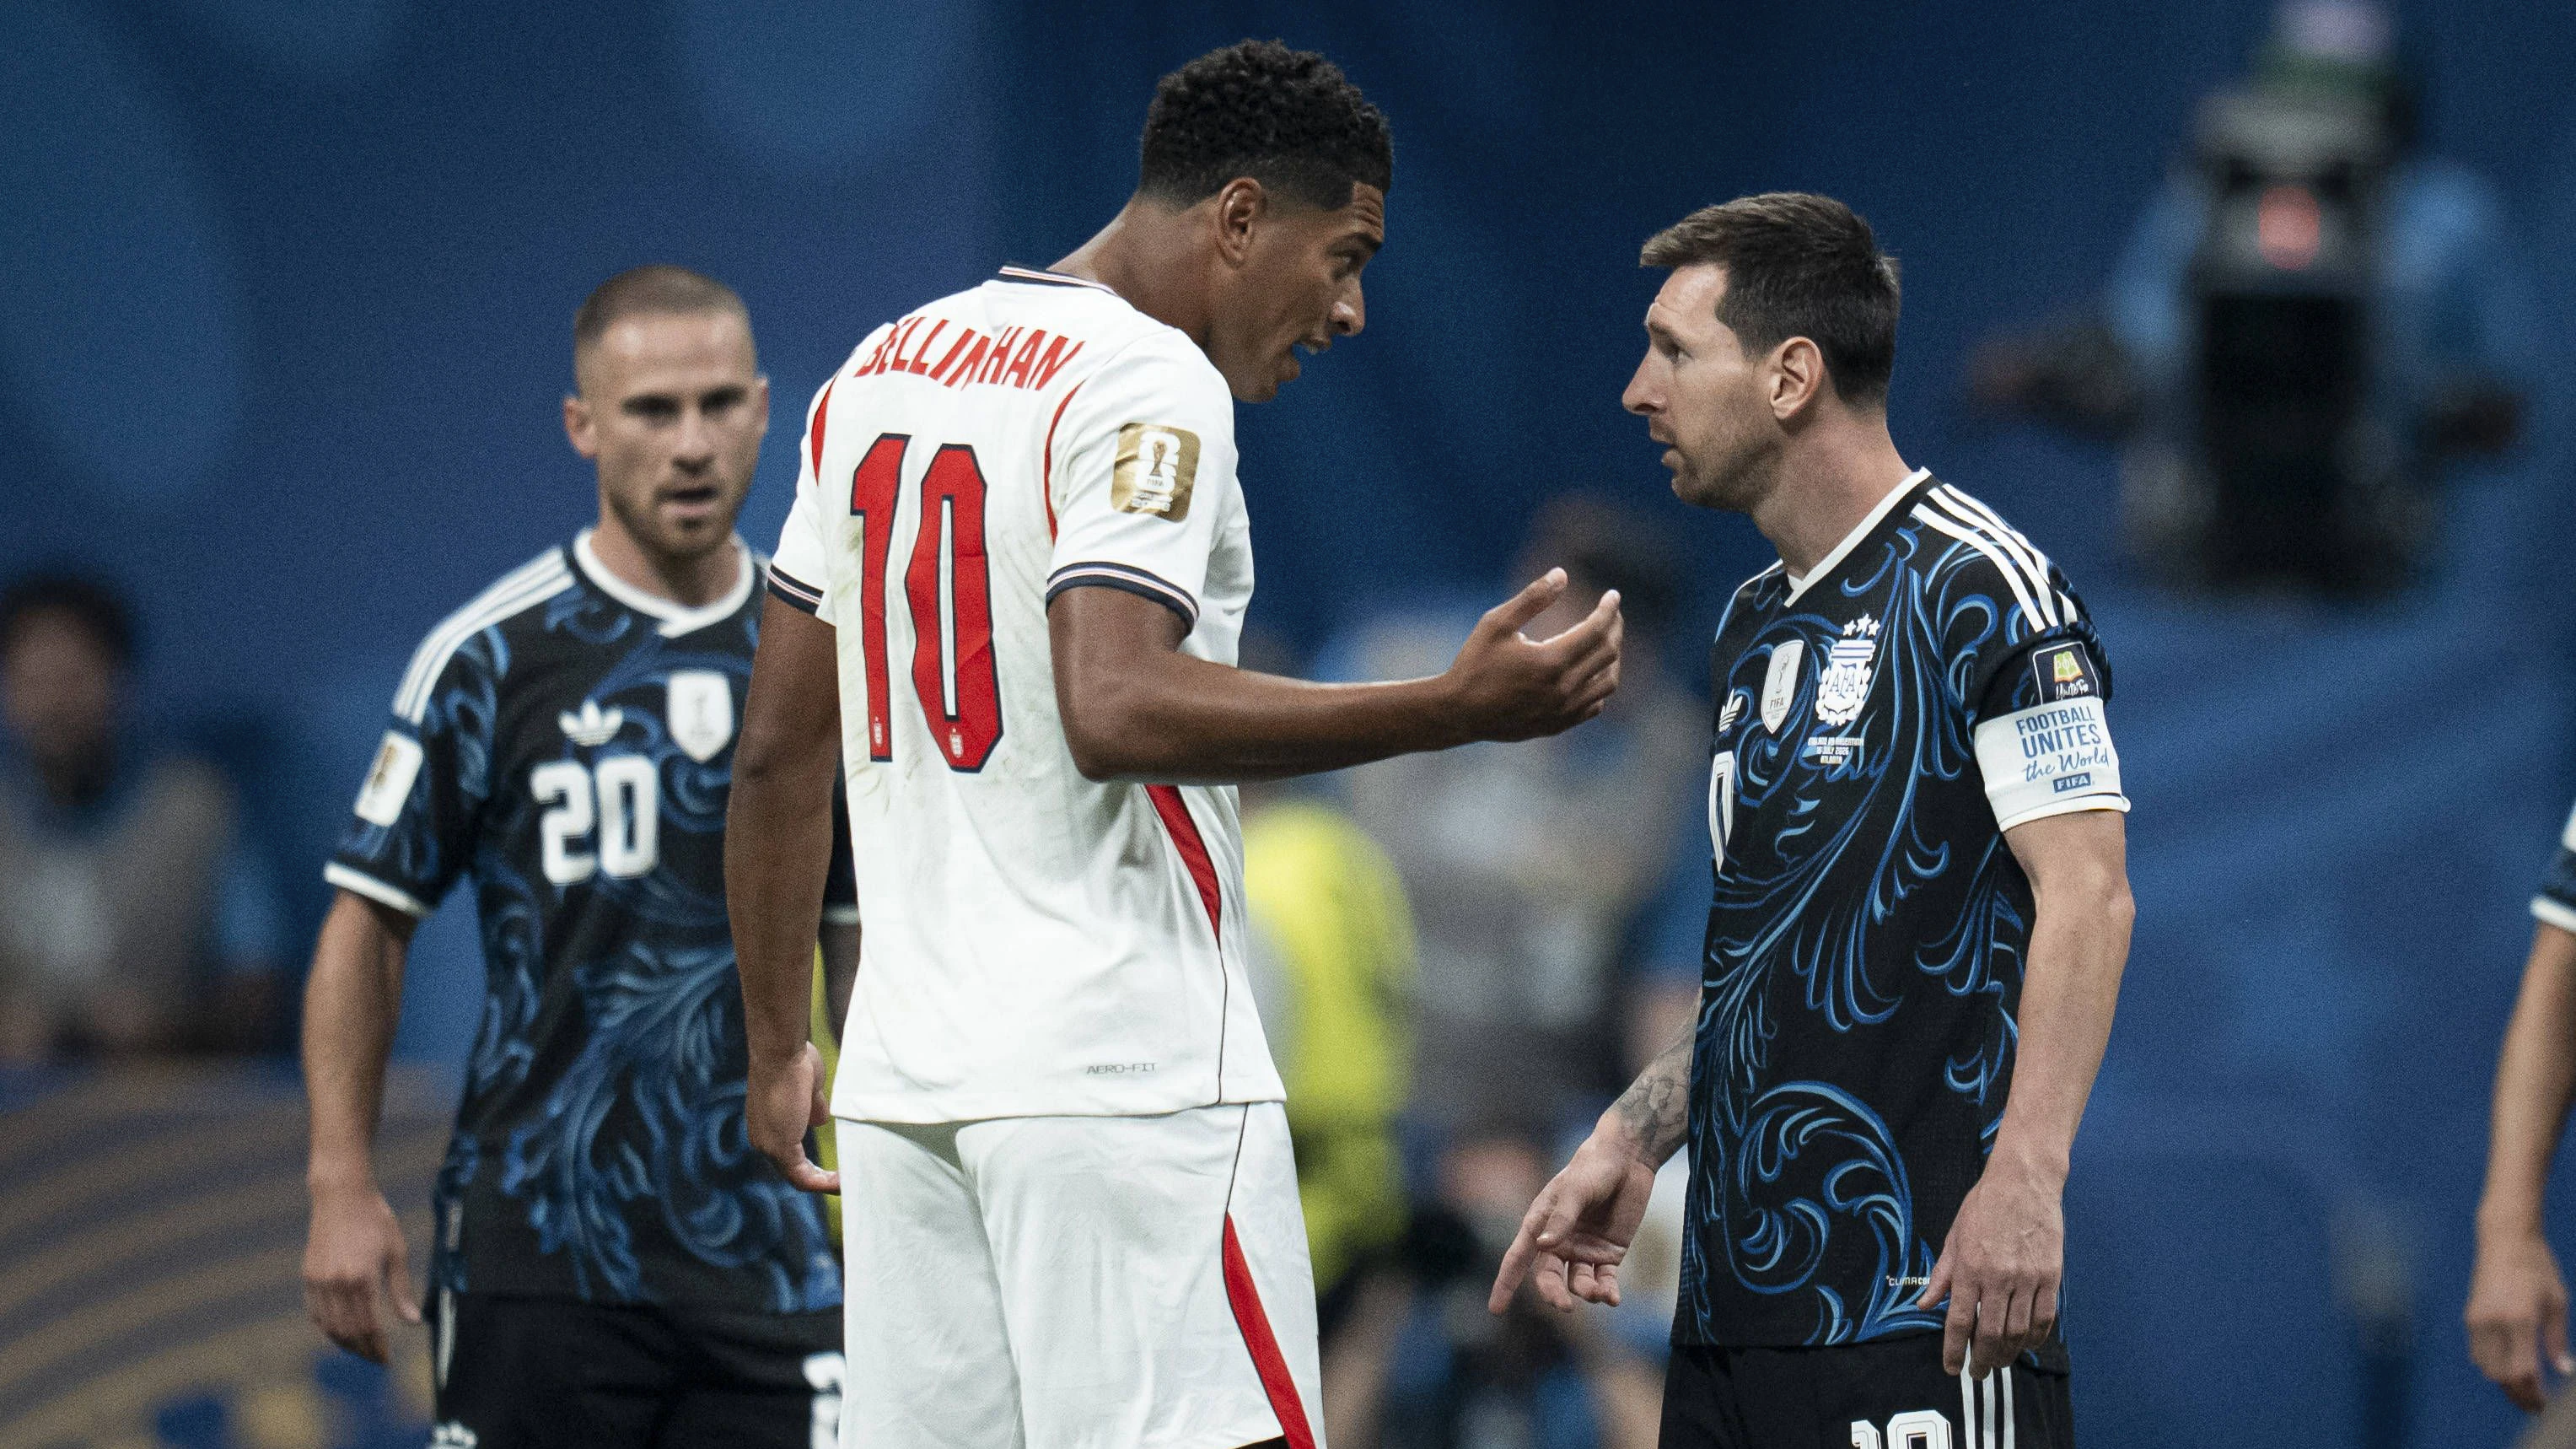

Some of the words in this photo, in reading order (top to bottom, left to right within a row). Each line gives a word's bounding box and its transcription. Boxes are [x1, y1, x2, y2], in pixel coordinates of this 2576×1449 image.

[850, 432, 1003, 773] 10
[1769, 697, 1784, 709] FIFA
[2015, 705, 2095, 735] FOOTBALL
[2021, 724, 2101, 759] UNITES
[2021, 760, 2055, 782] the
[2057, 746, 2109, 772] World
[2057, 775, 2089, 790] FIFA
[530, 755, 660, 885] 20
[1086, 1063, 1158, 1075] AERO-FIT
